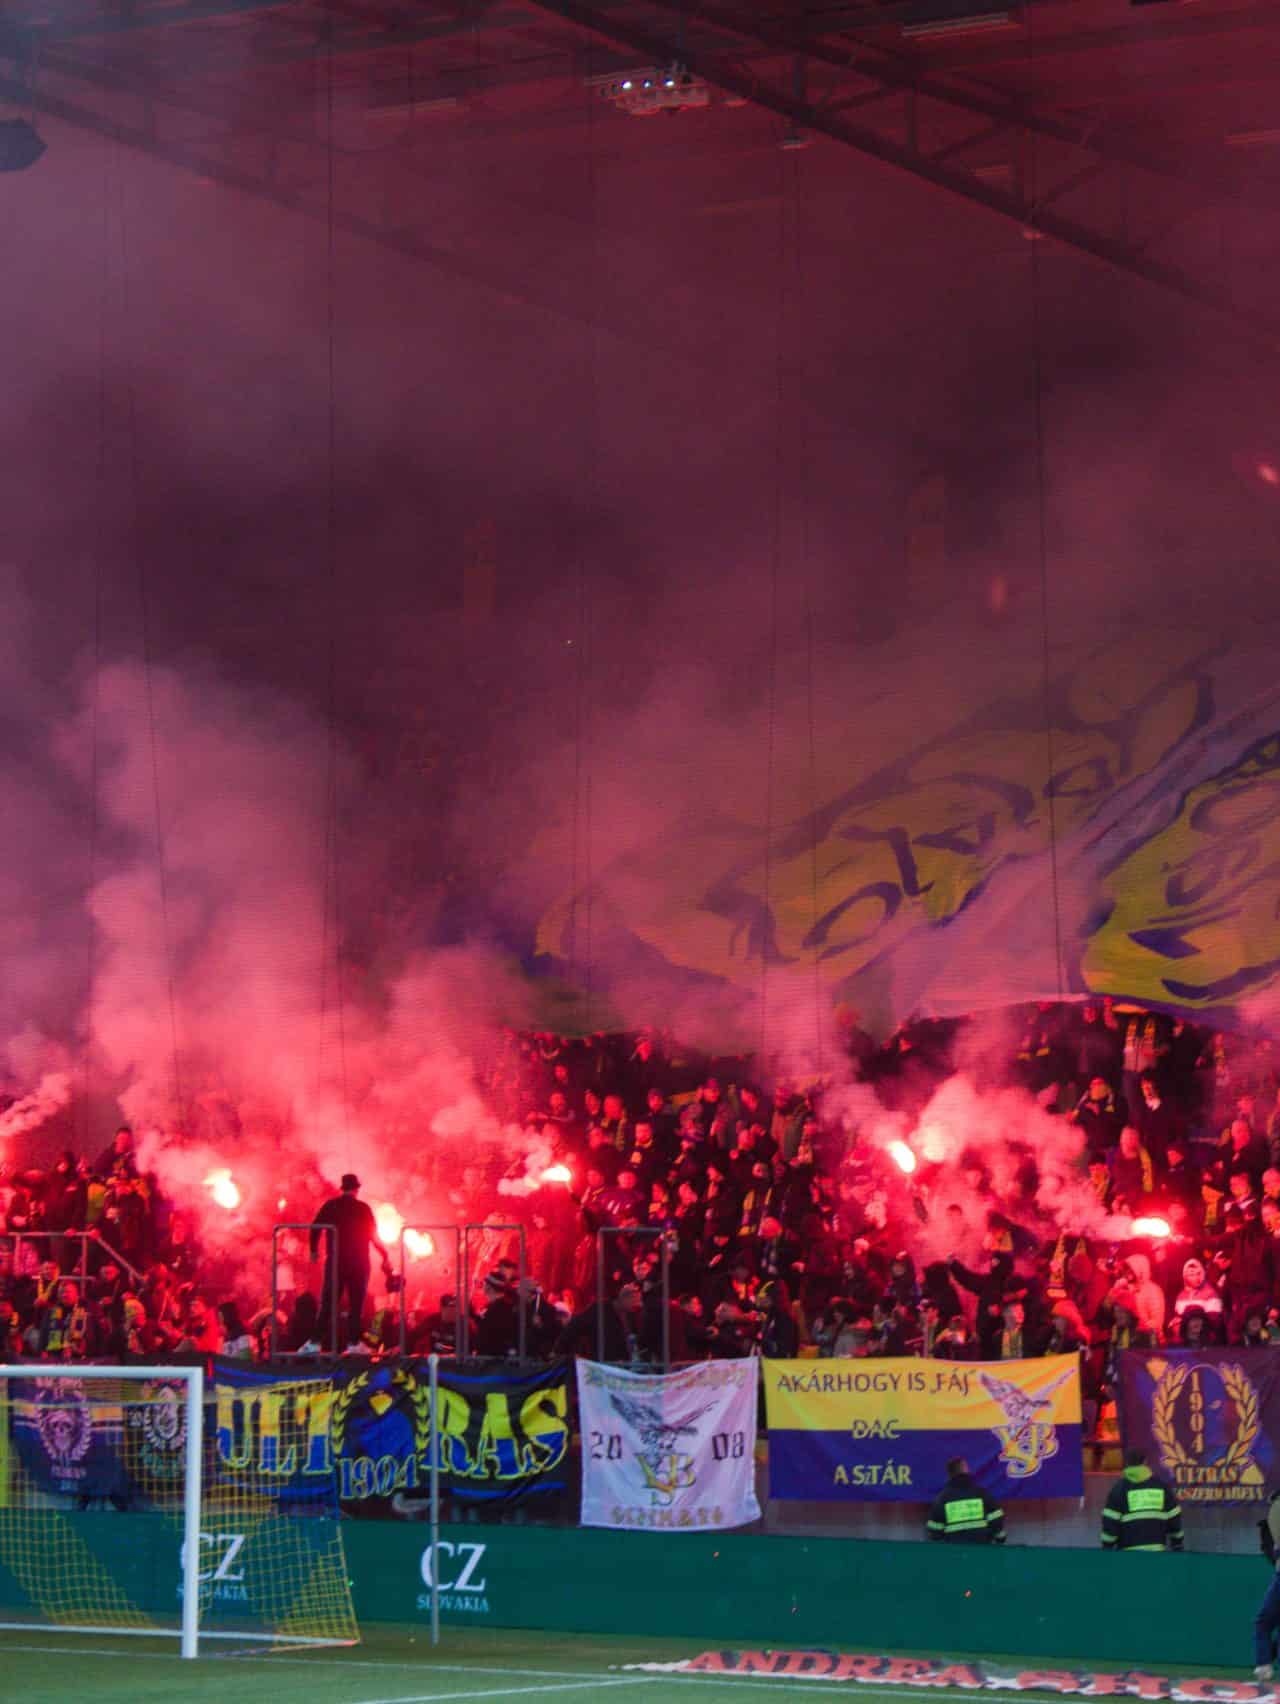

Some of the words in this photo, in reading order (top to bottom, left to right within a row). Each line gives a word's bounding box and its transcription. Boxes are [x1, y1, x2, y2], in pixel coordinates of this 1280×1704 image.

[777, 1369, 900, 1393] AKÁRHOGY
[908, 1372, 926, 1391] IS
[852, 1419, 901, 1439] DAC
[591, 1431, 622, 1460] 20
[339, 1454, 420, 1499] 1904
[834, 1465, 849, 1484] A
[420, 1541, 487, 1591] CZ
[685, 1650, 988, 1690] ANDREA
